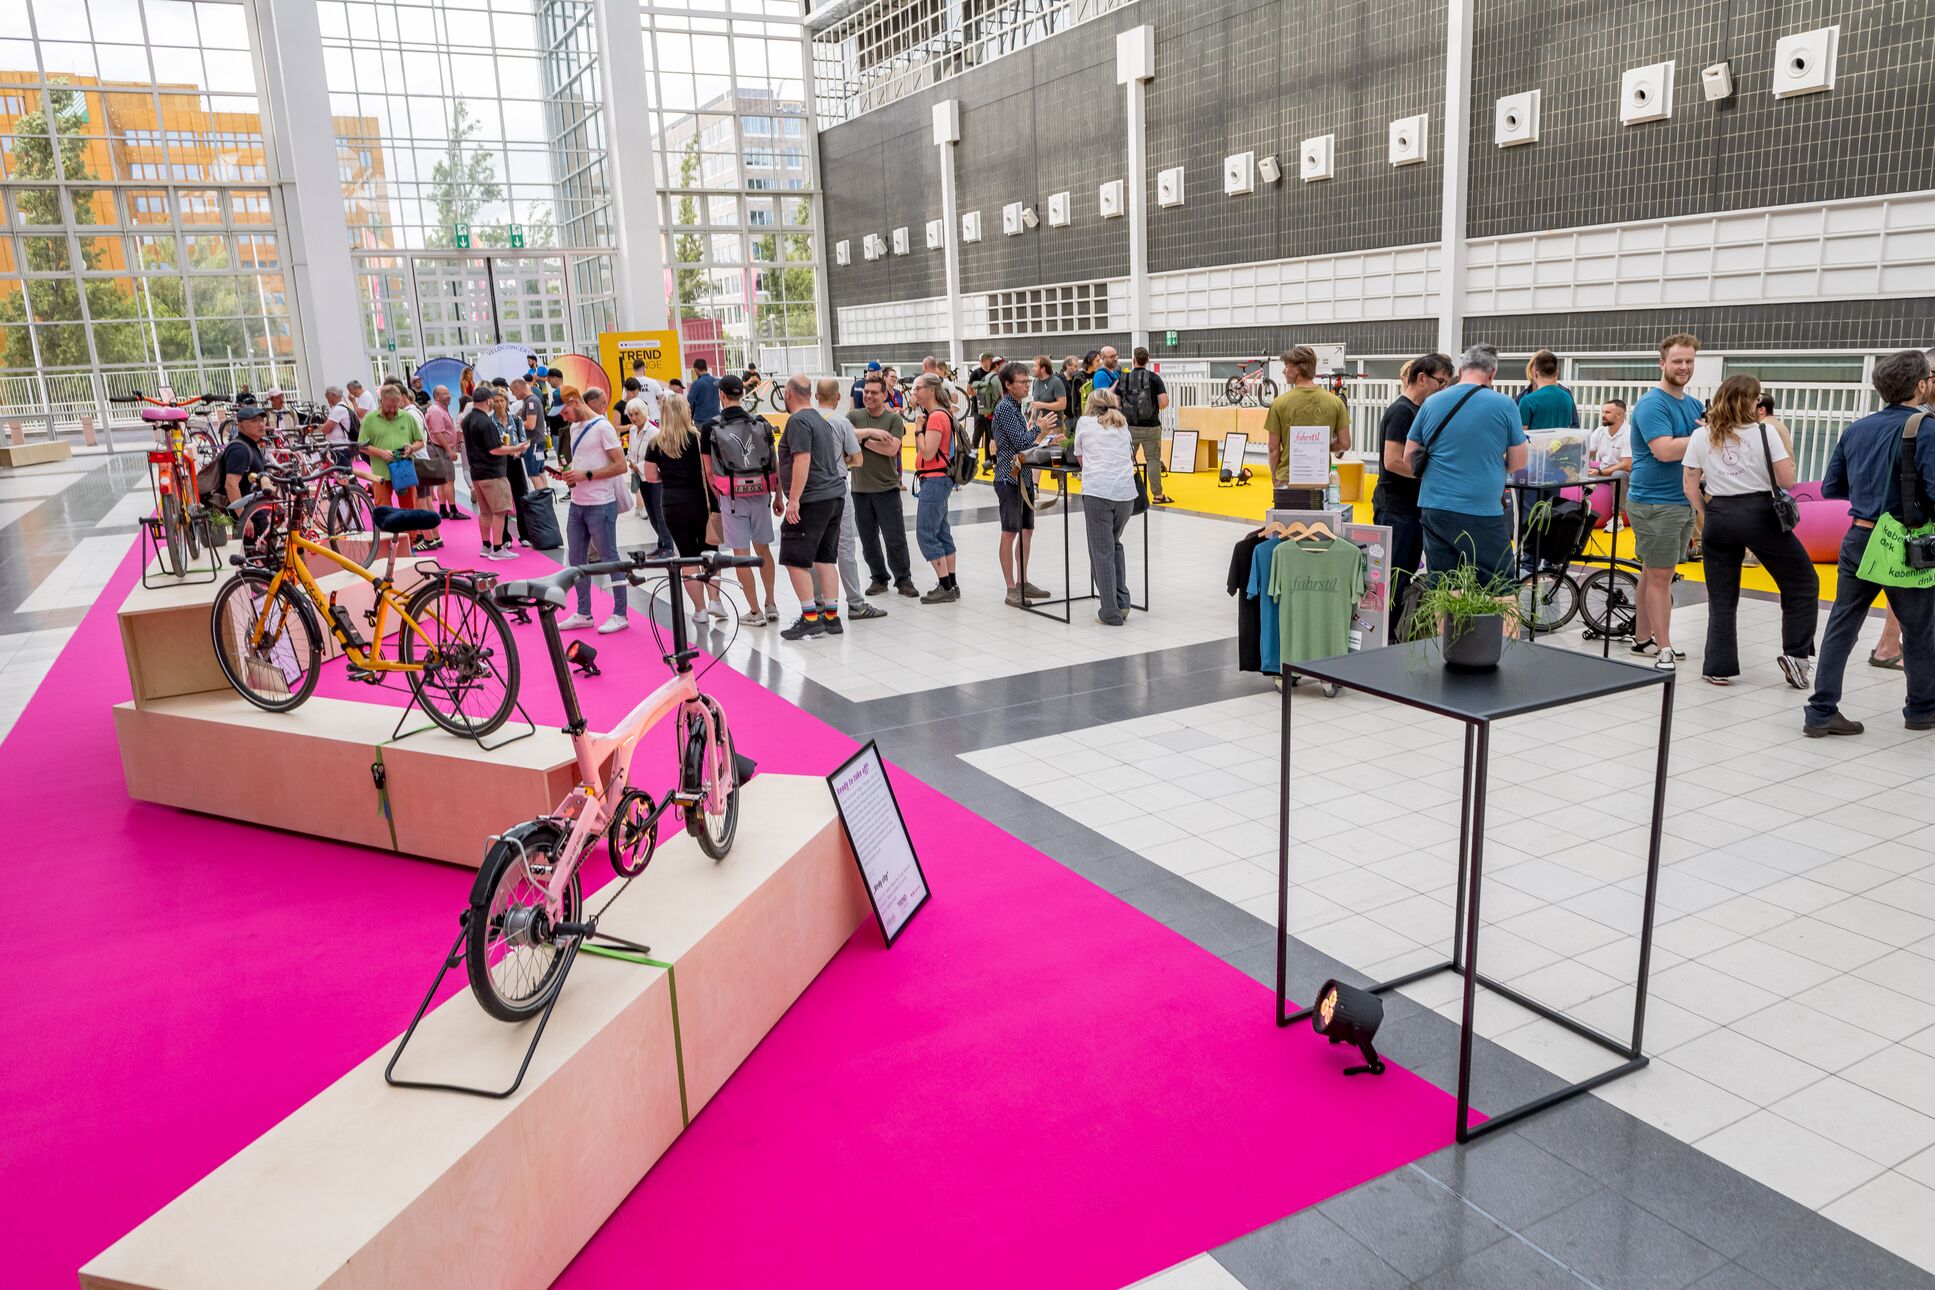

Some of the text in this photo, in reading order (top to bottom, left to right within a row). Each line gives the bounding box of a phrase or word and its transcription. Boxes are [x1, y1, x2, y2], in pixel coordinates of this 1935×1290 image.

[619, 349, 662, 361] TREND
[1289, 575, 1338, 593] fahrstil
[836, 781, 850, 796] Ready
